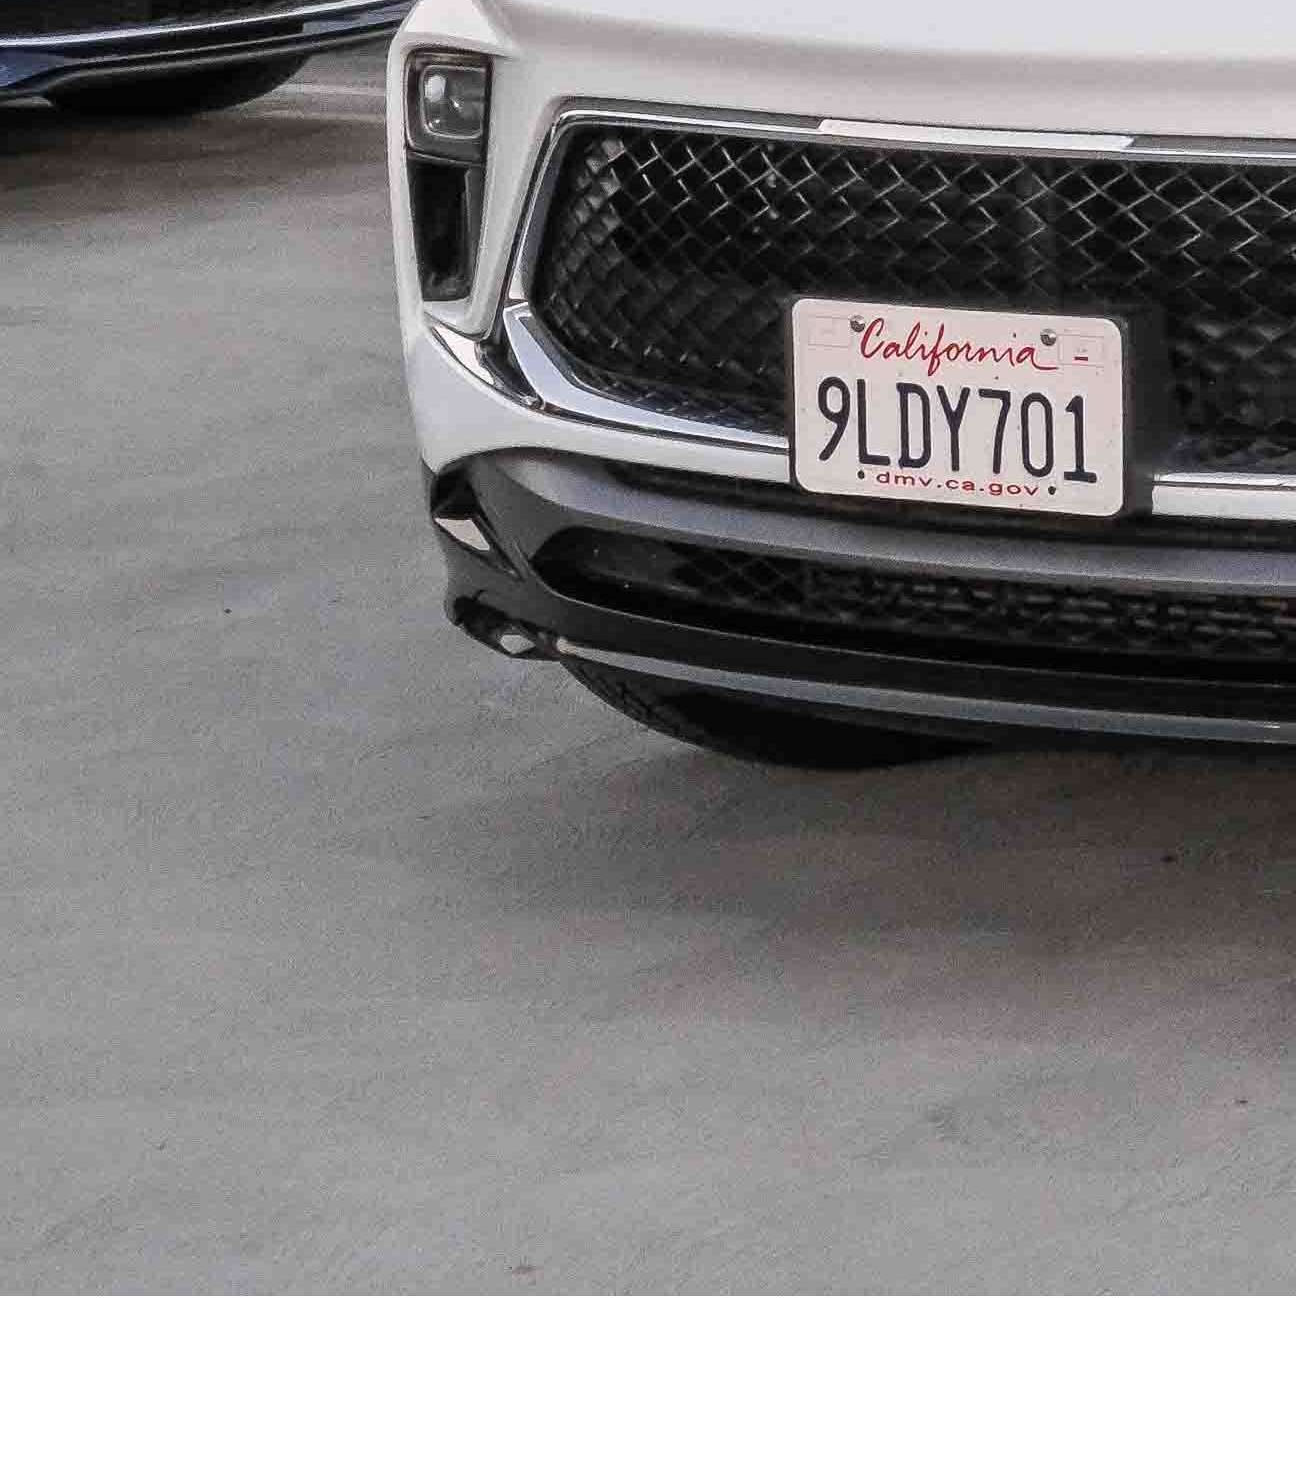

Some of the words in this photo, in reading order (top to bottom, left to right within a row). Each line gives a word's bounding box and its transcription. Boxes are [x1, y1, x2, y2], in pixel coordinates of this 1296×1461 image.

[860, 317, 1059, 376] California
[817, 376, 1098, 483] 9LDY701
[876, 470, 1040, 497] dmv.ca.gov
